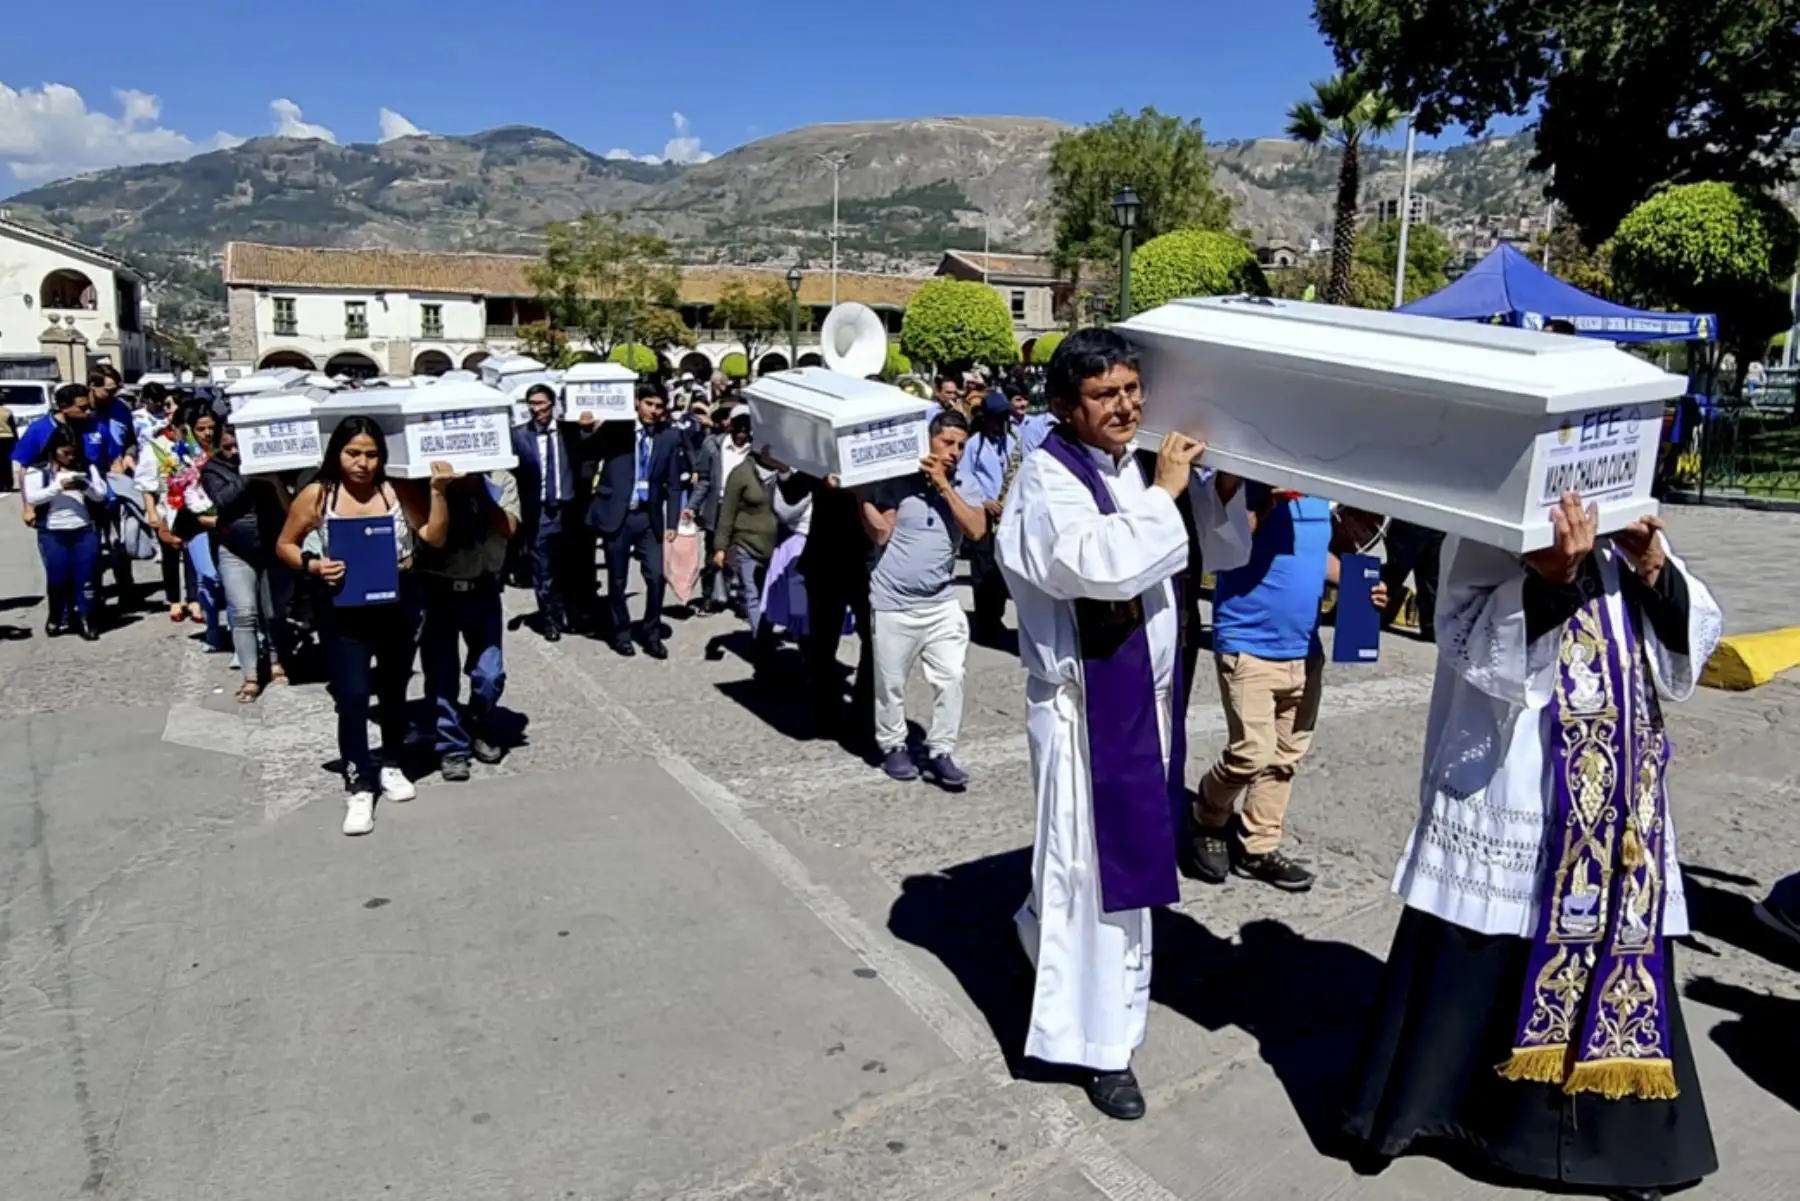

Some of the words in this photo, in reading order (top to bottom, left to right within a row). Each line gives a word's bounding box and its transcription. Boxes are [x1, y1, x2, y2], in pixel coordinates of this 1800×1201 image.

[442, 412, 474, 427] EFE
[868, 420, 896, 436] EFE
[1581, 408, 1622, 442] EFE
[1544, 461, 1573, 500] MARIO
[1572, 455, 1609, 490] CHALCO
